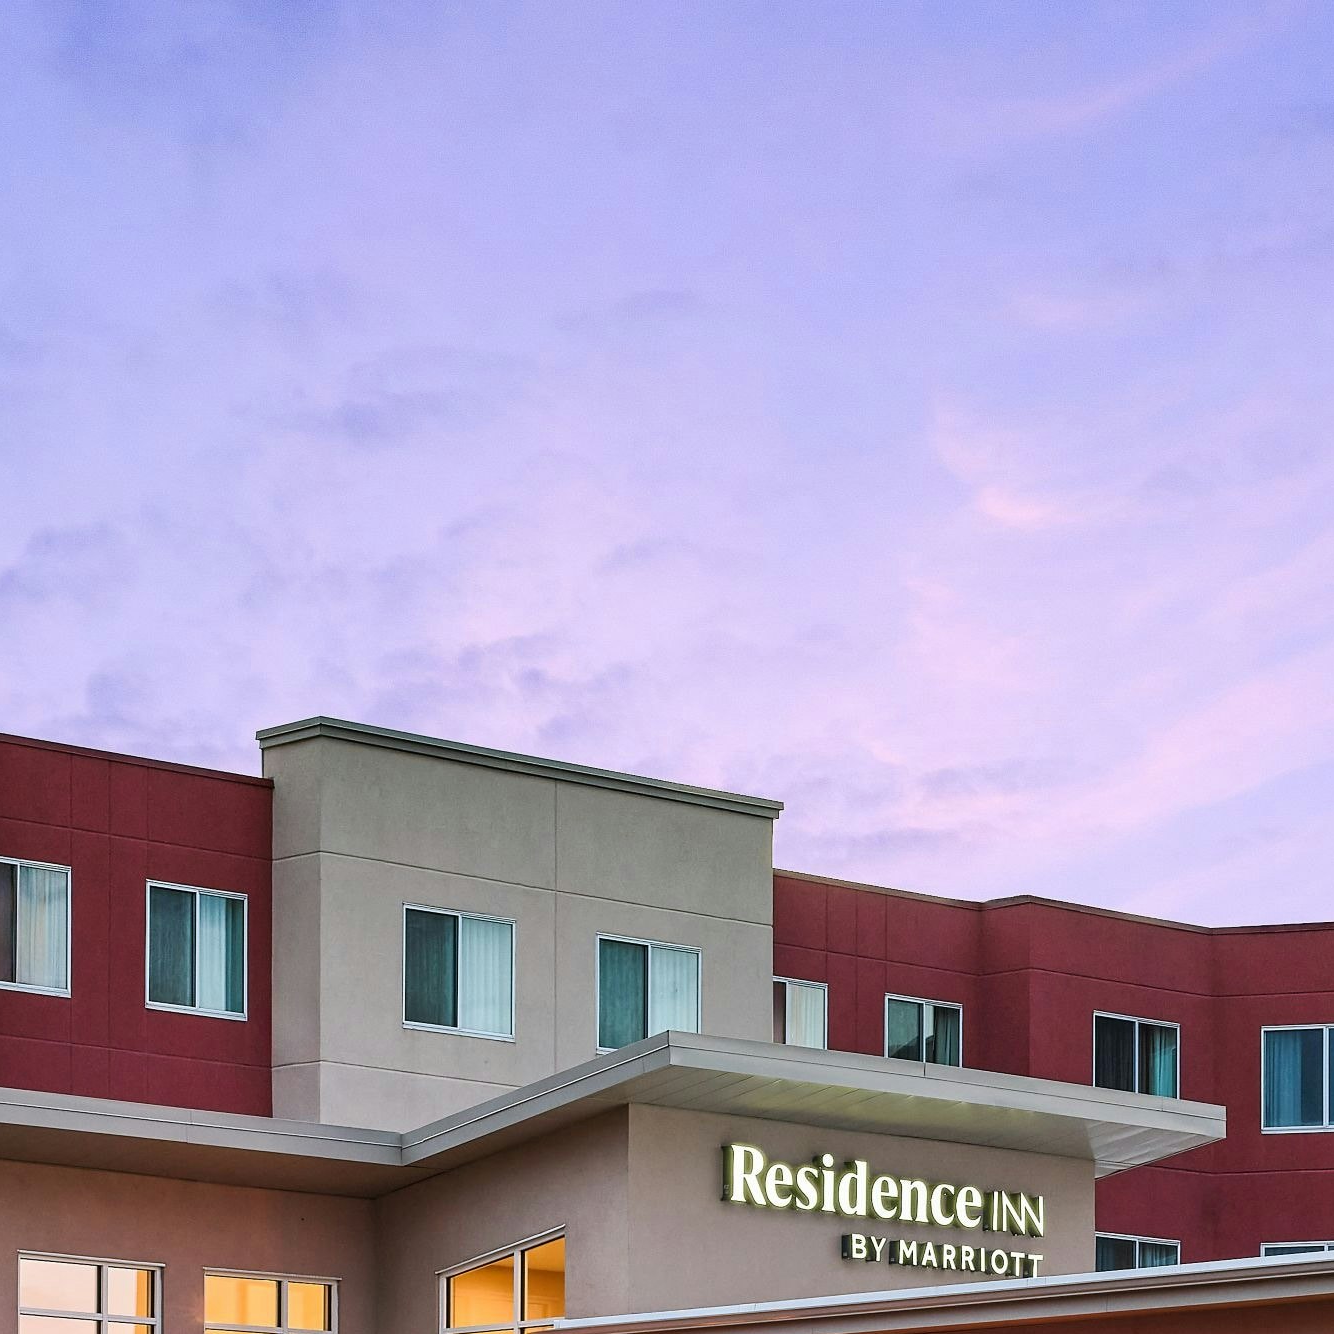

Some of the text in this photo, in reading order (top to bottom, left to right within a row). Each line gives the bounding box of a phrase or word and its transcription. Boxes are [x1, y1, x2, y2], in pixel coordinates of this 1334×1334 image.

[729, 1144, 1044, 1237] Residence INN
[851, 1233, 1044, 1278] BY MARRIOTT
